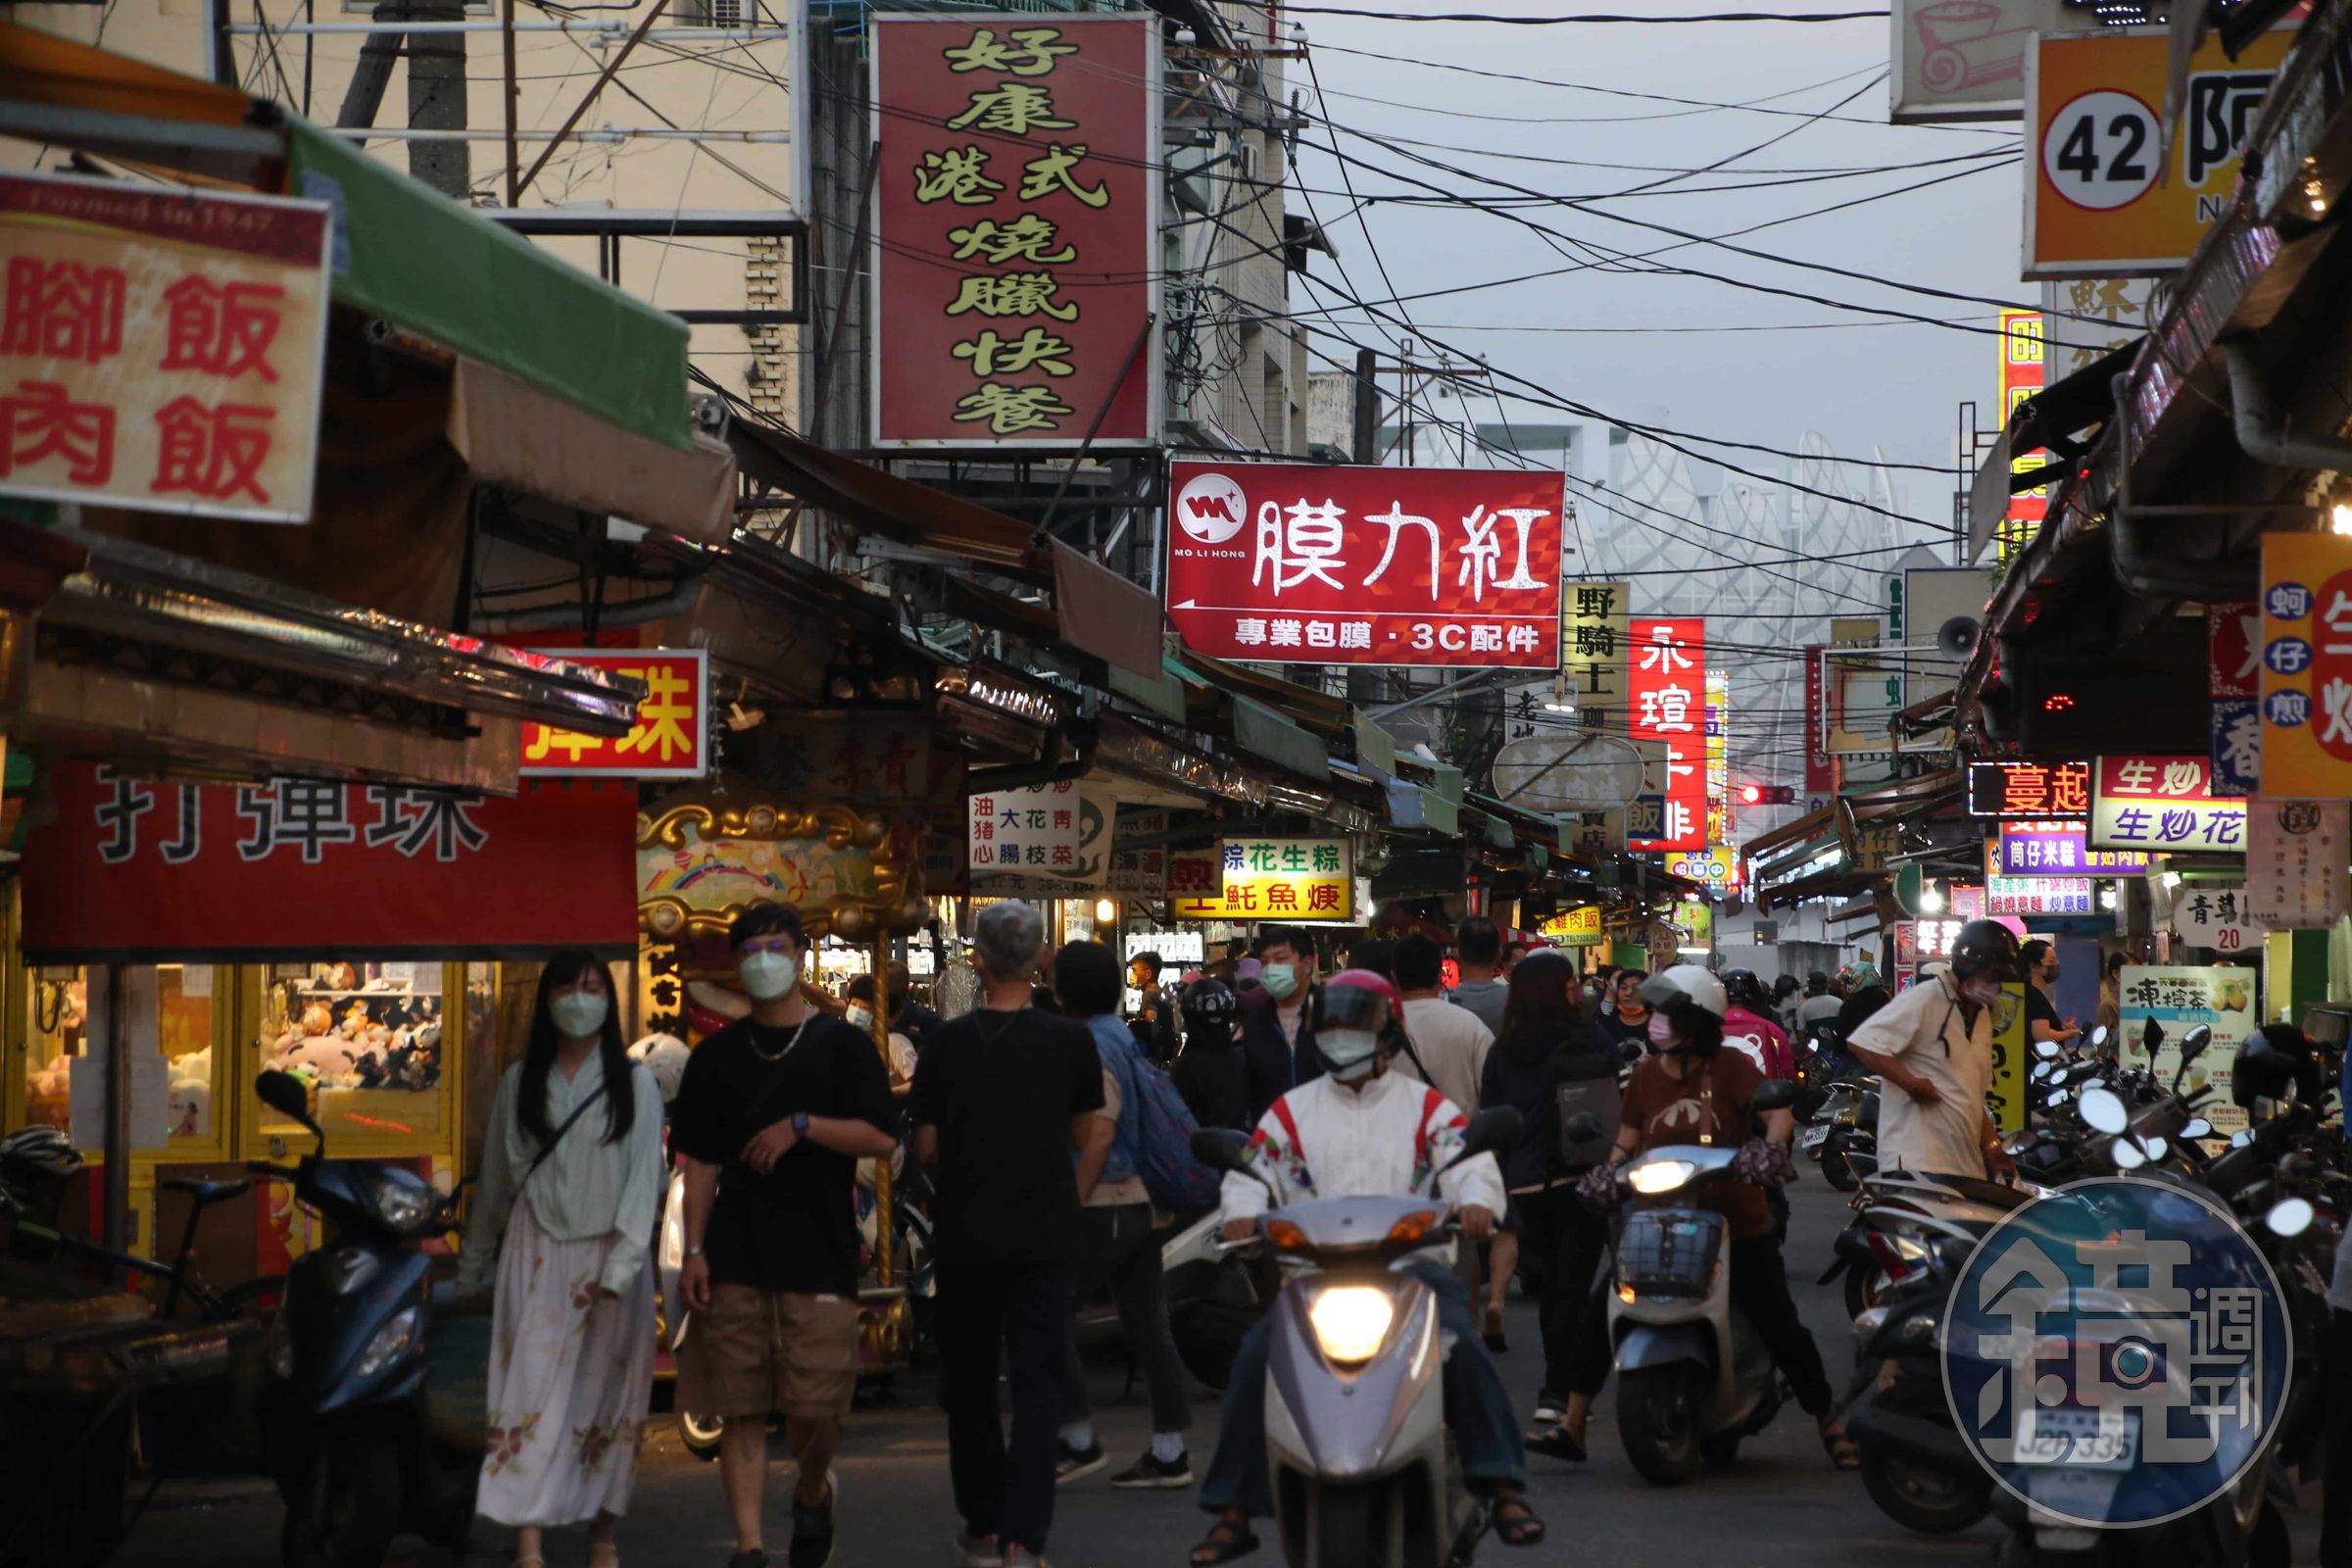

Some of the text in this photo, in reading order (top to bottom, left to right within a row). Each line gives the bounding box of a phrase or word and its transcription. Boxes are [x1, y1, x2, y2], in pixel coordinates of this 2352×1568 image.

[2056, 114, 2146, 182] 42
[1174, 548, 1246, 560] MO LI HONG
[1251, 497, 1552, 603] 膜力紅
[524, 665, 693, 762] 珠
[2112, 760, 2212, 796] 生炒
[95, 764, 489, 862] 打彈珠
[2219, 928, 2240, 949] 20
